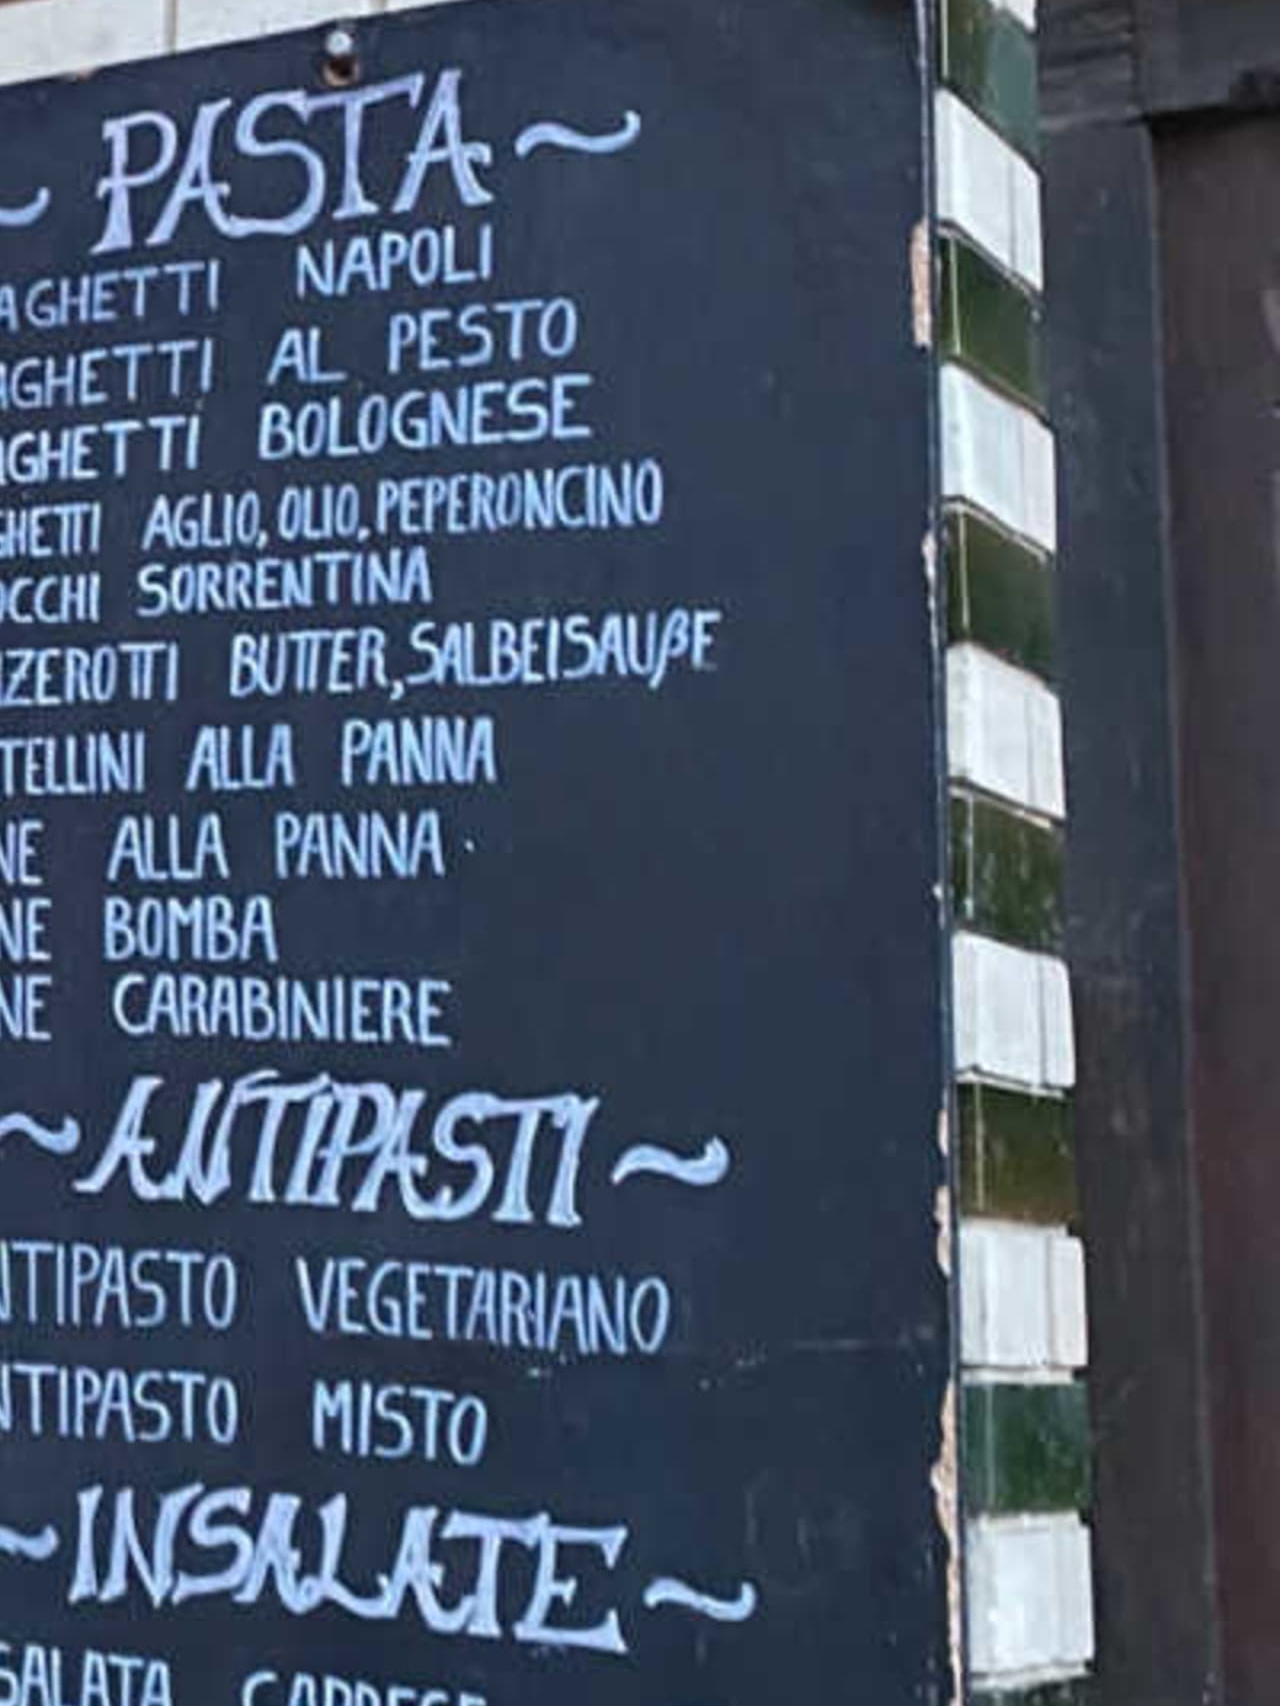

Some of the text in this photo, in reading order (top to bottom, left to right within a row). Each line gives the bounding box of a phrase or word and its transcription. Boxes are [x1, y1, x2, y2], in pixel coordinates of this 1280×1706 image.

[91, 68, 495, 255] PASTA
[296, 224, 493, 300] NAPOLI
[267, 325, 346, 387] AL
[389, 298, 579, 375] PESTO
[258, 373, 593, 461] BOLOGNESE
[136, 546, 432, 619] SORRENTINA
[184, 721, 296, 793] ALLA
[341, 716, 498, 788] PANNA
[106, 813, 231, 882] ALLA
[275, 809, 445, 880] PANNA
[103, 893, 279, 964] BOMBA
[112, 973, 452, 1047] CARABINIERE
[73, 1068, 603, 1228] ANTIPASTI
[296, 1256, 671, 1356] VEGETARIANO
[312, 1379, 489, 1466] MISTO
[69, 1483, 630, 1654] INSALATE
